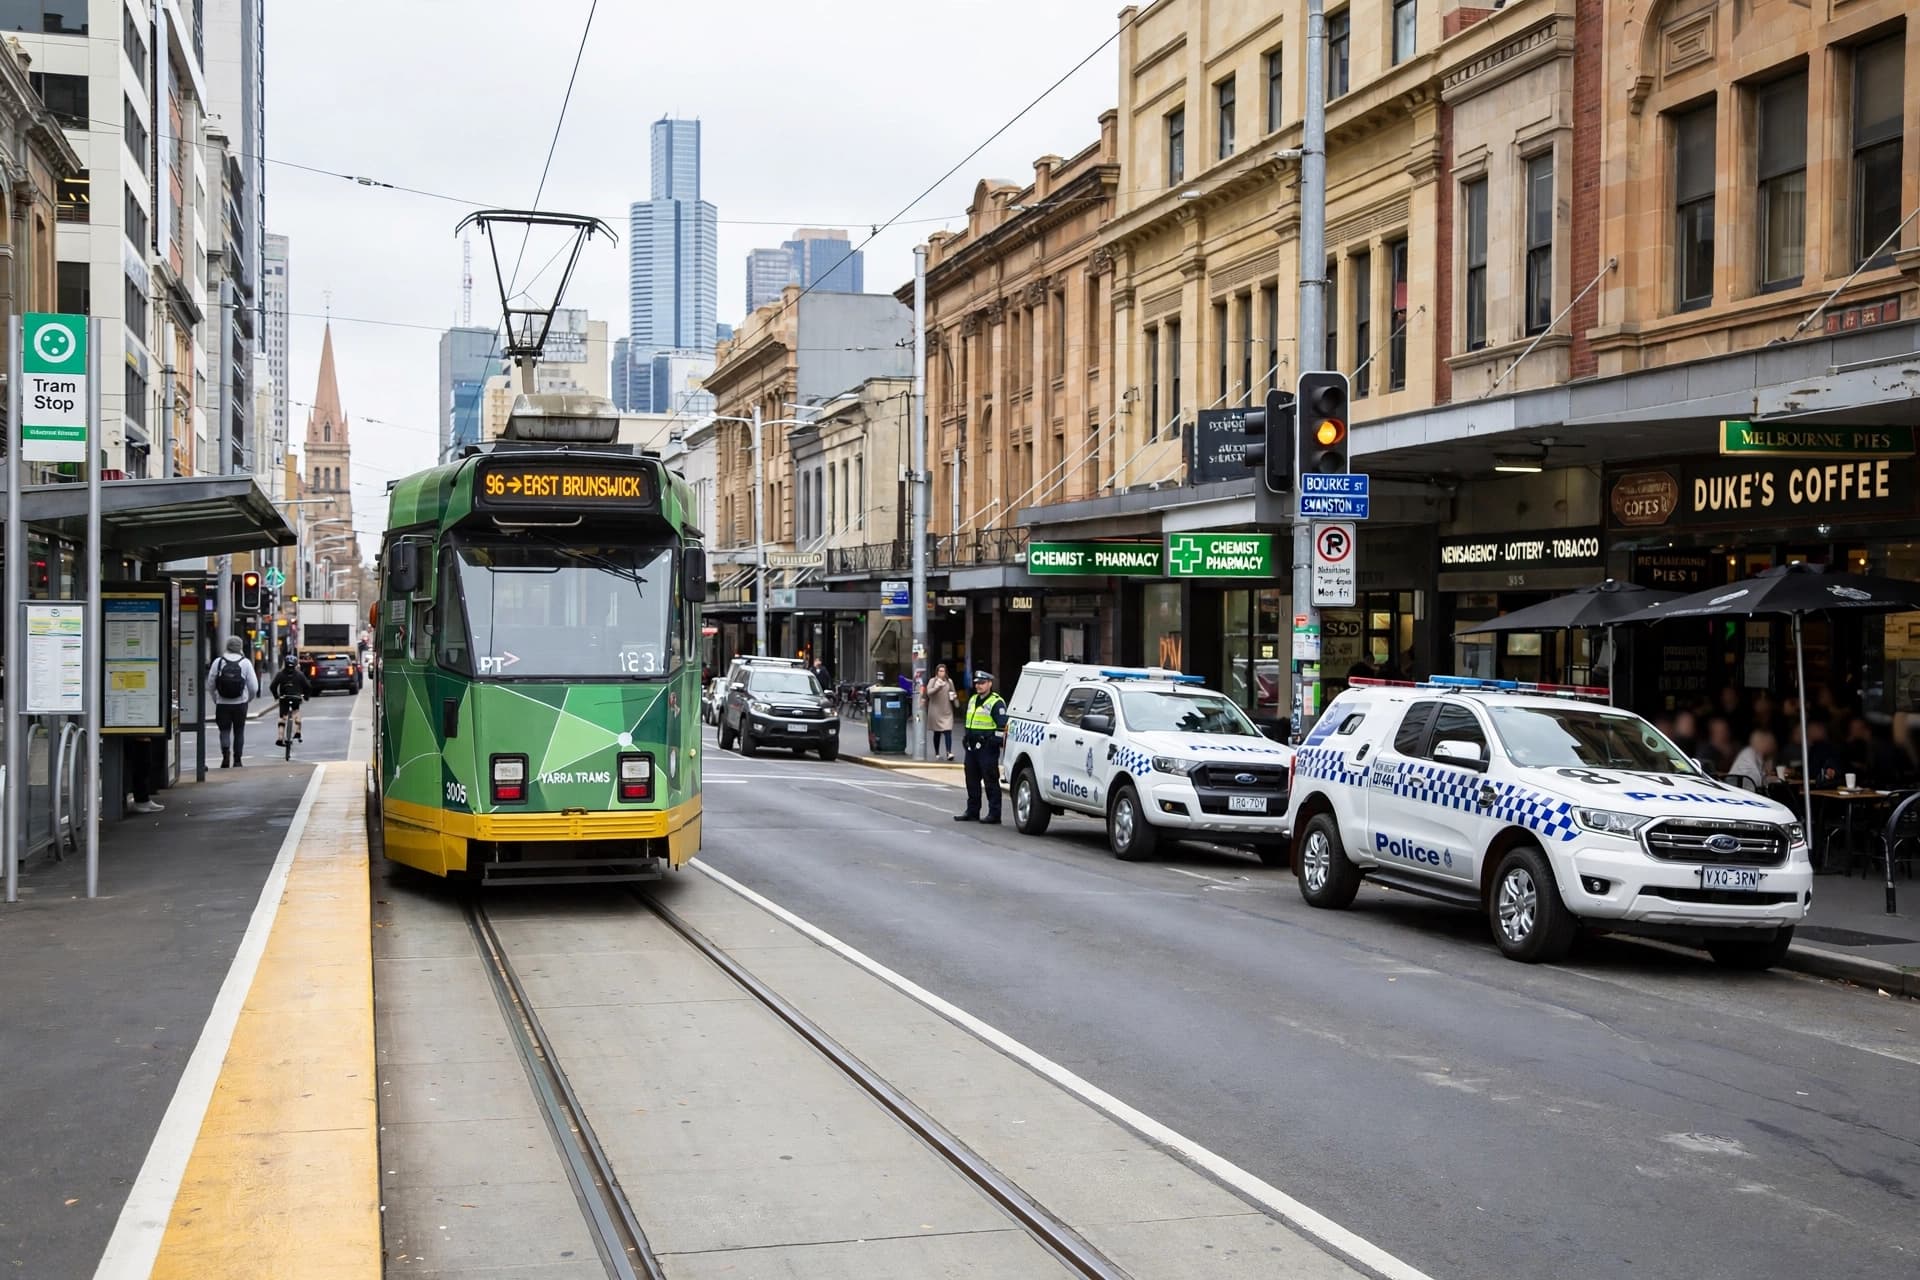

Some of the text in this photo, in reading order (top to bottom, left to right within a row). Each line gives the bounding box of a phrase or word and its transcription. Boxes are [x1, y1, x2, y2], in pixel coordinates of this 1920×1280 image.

[33, 378, 76, 393] Tram
[34, 395, 74, 413] Stop
[1854, 433, 1890, 448] PIES
[486, 474, 641, 497] 96 EAST BRUNSWICK
[1306, 477, 1350, 491] BOURKE
[1694, 460, 1890, 512] DUKE'S COFFEE
[1211, 541, 1259, 555] CHEMIST
[1441, 537, 1599, 564] NEWSAGENCY LOTTERY TOBACCO
[1031, 552, 1084, 566] CHEMIST
[541, 772, 611, 784] YARRA TRAMS
[1052, 774, 1088, 798] Police
[446, 781, 467, 805] 3005
[1624, 791, 1773, 809] Police
[1375, 832, 1440, 866] Police
